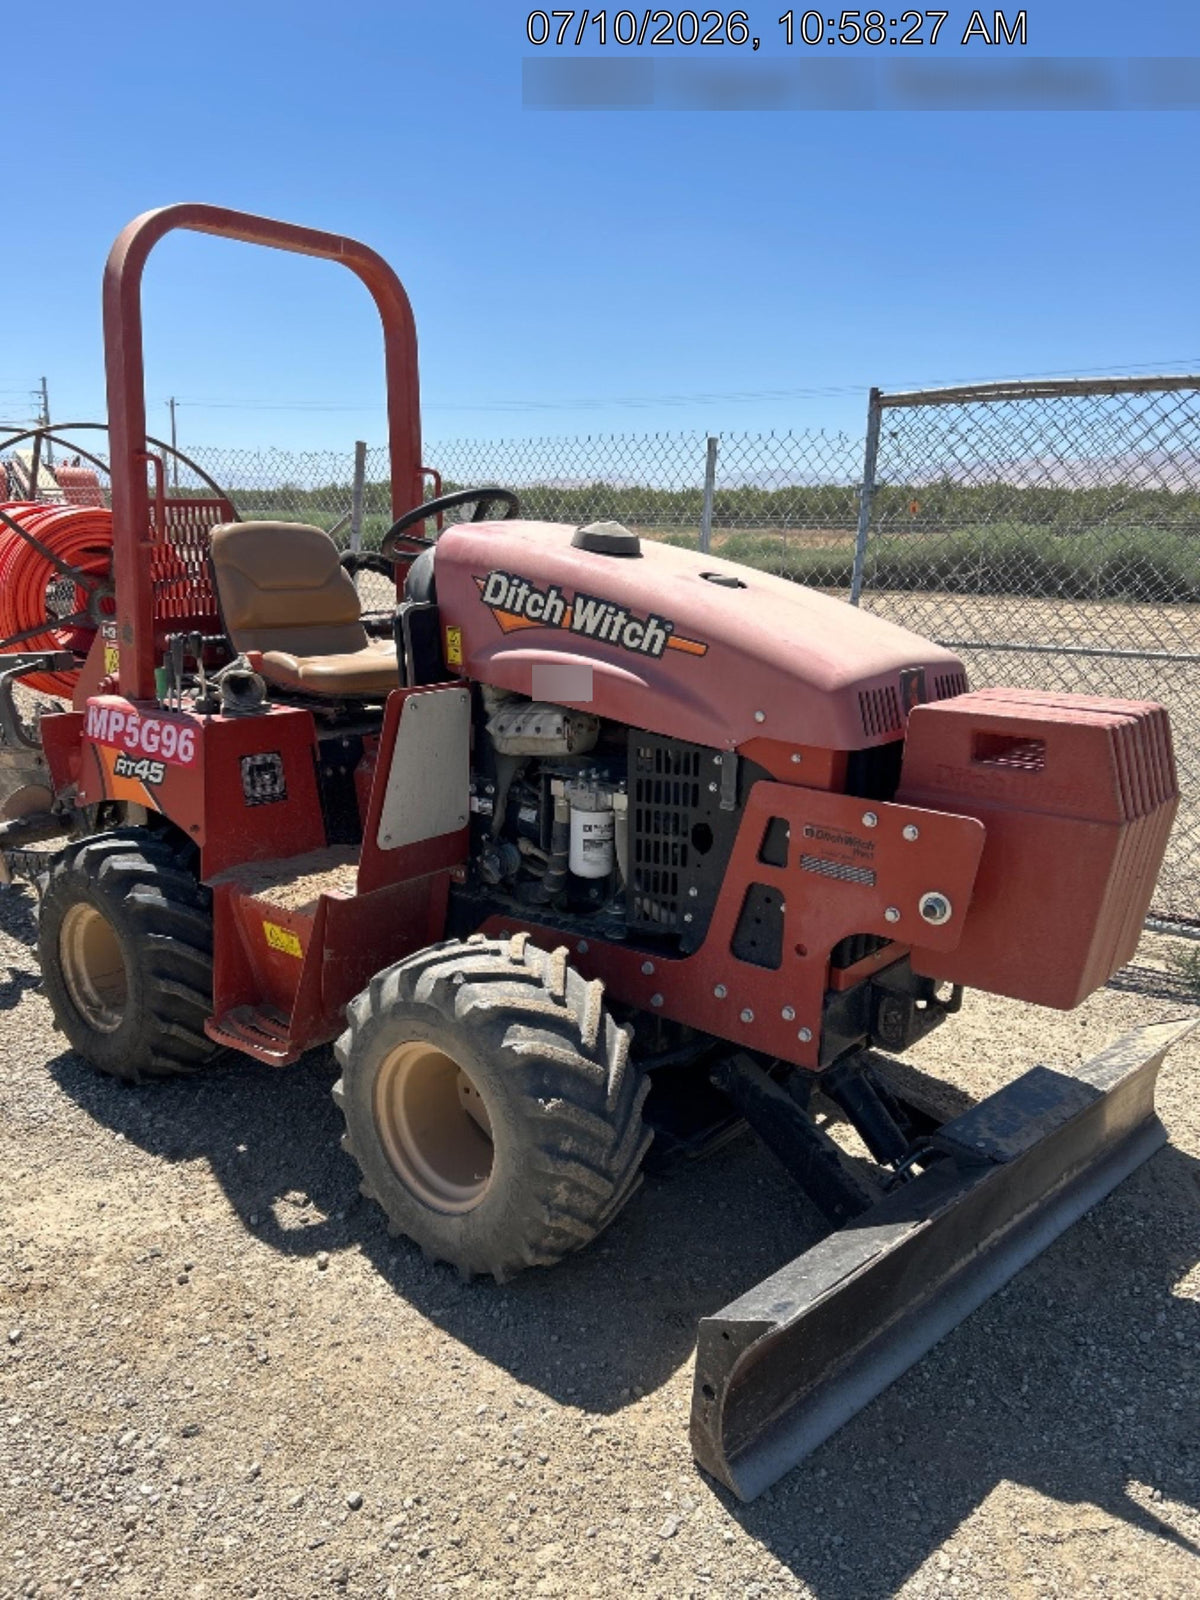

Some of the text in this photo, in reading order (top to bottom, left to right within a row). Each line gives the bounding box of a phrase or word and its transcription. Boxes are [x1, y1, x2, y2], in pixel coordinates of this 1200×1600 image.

[482, 572, 566, 626] Ditch
[86, 705, 196, 763] MP5G96
[115, 758, 165, 784] RT45
